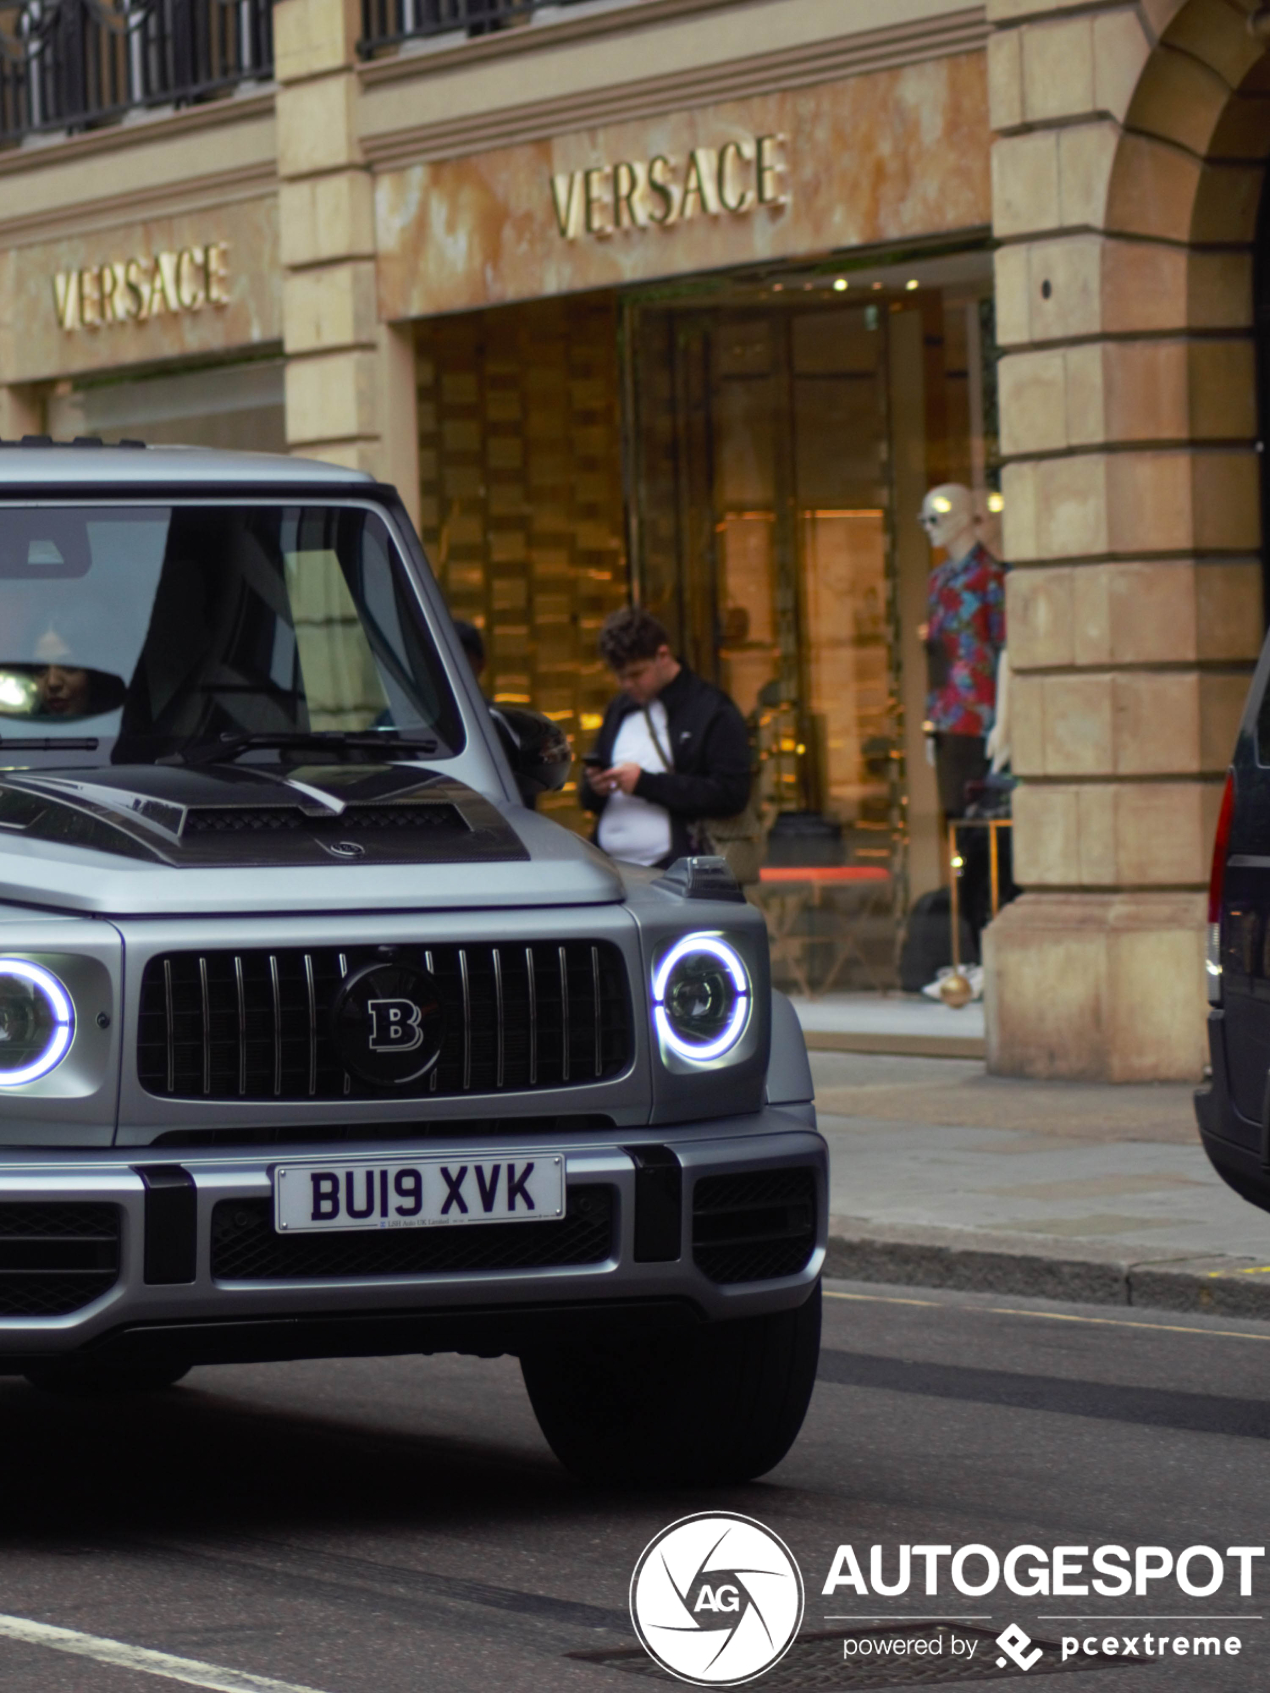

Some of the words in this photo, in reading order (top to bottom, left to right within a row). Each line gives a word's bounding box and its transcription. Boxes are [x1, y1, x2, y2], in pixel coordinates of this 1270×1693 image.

[551, 134, 788, 238] VERSACE
[53, 244, 230, 331] VERSACE
[368, 999, 424, 1052] B
[310, 1168, 423, 1221] BU19
[440, 1162, 535, 1215] XVK
